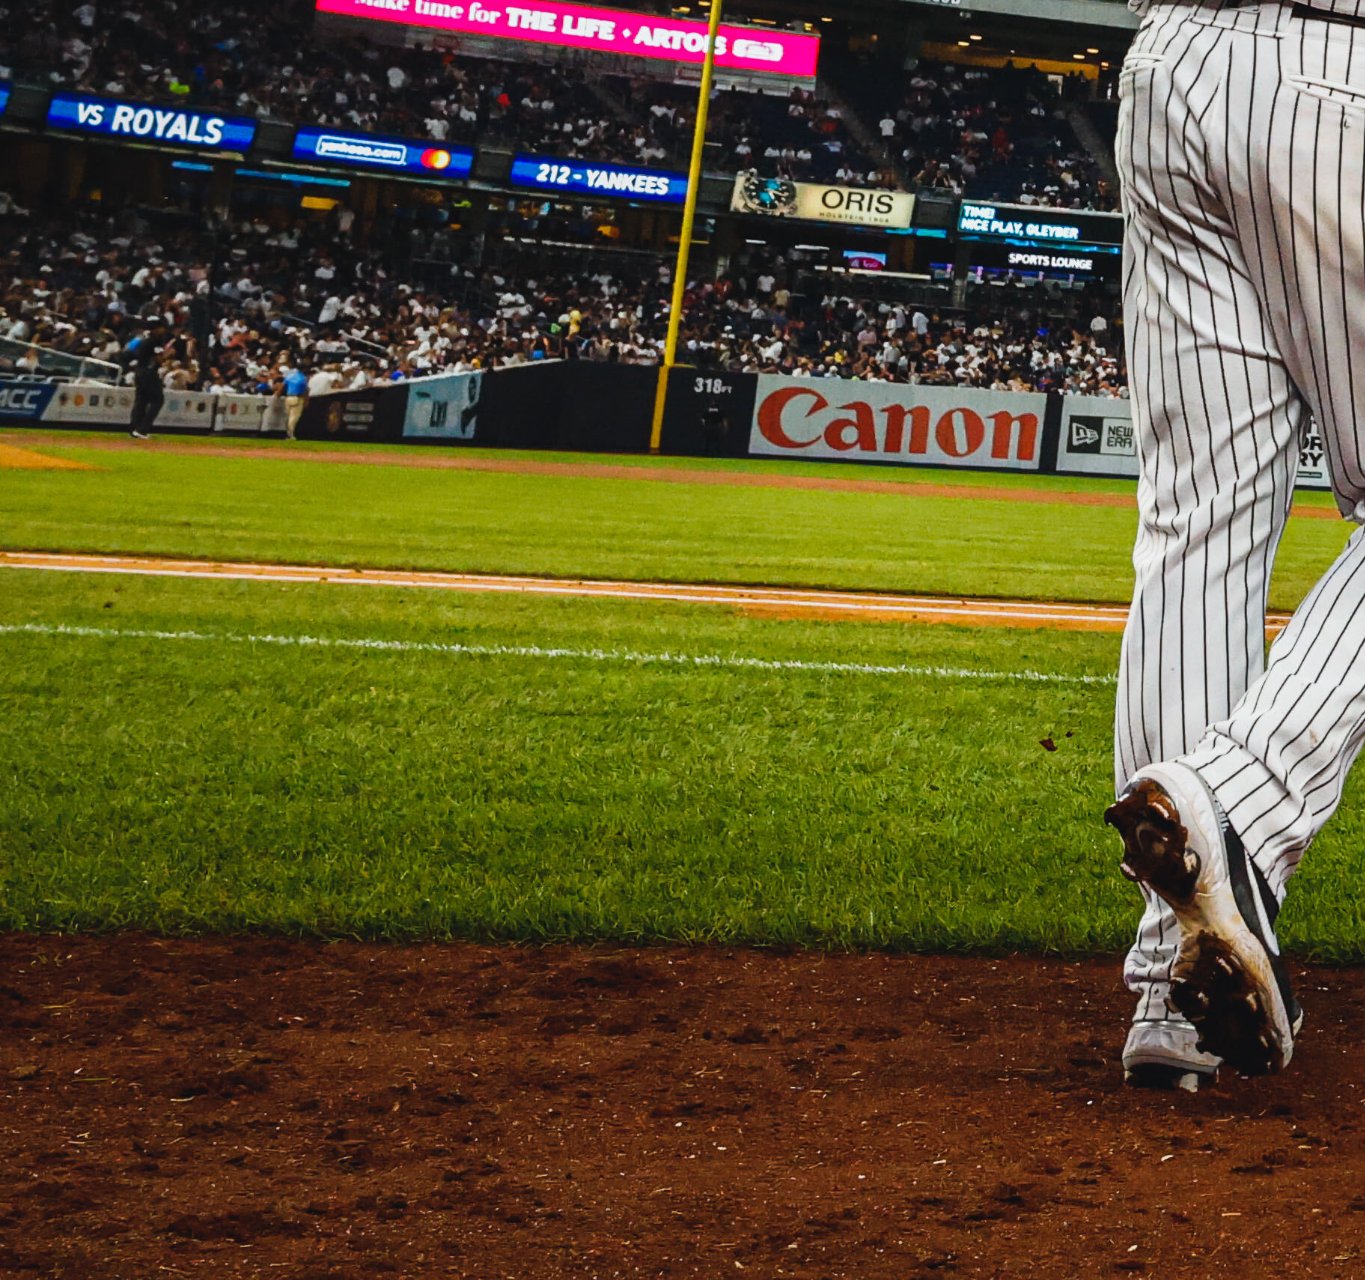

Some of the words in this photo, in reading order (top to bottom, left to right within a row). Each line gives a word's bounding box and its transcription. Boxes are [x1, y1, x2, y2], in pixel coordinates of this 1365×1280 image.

[468, 2, 502, 24] for
[505, 7, 556, 32] THE
[561, 15, 616, 40] LIFE
[111, 105, 224, 144] ROYALS
[821, 189, 894, 214] ORIS
[960, 218, 989, 232] NICE
[991, 222, 1024, 237] PLAY,
[1008, 252, 1050, 267] SPORTS
[1051, 256, 1093, 270] LOUNGE
[757, 386, 1039, 461] Canon
[1108, 426, 1133, 437] NEW
[1107, 437, 1132, 448] ERA
